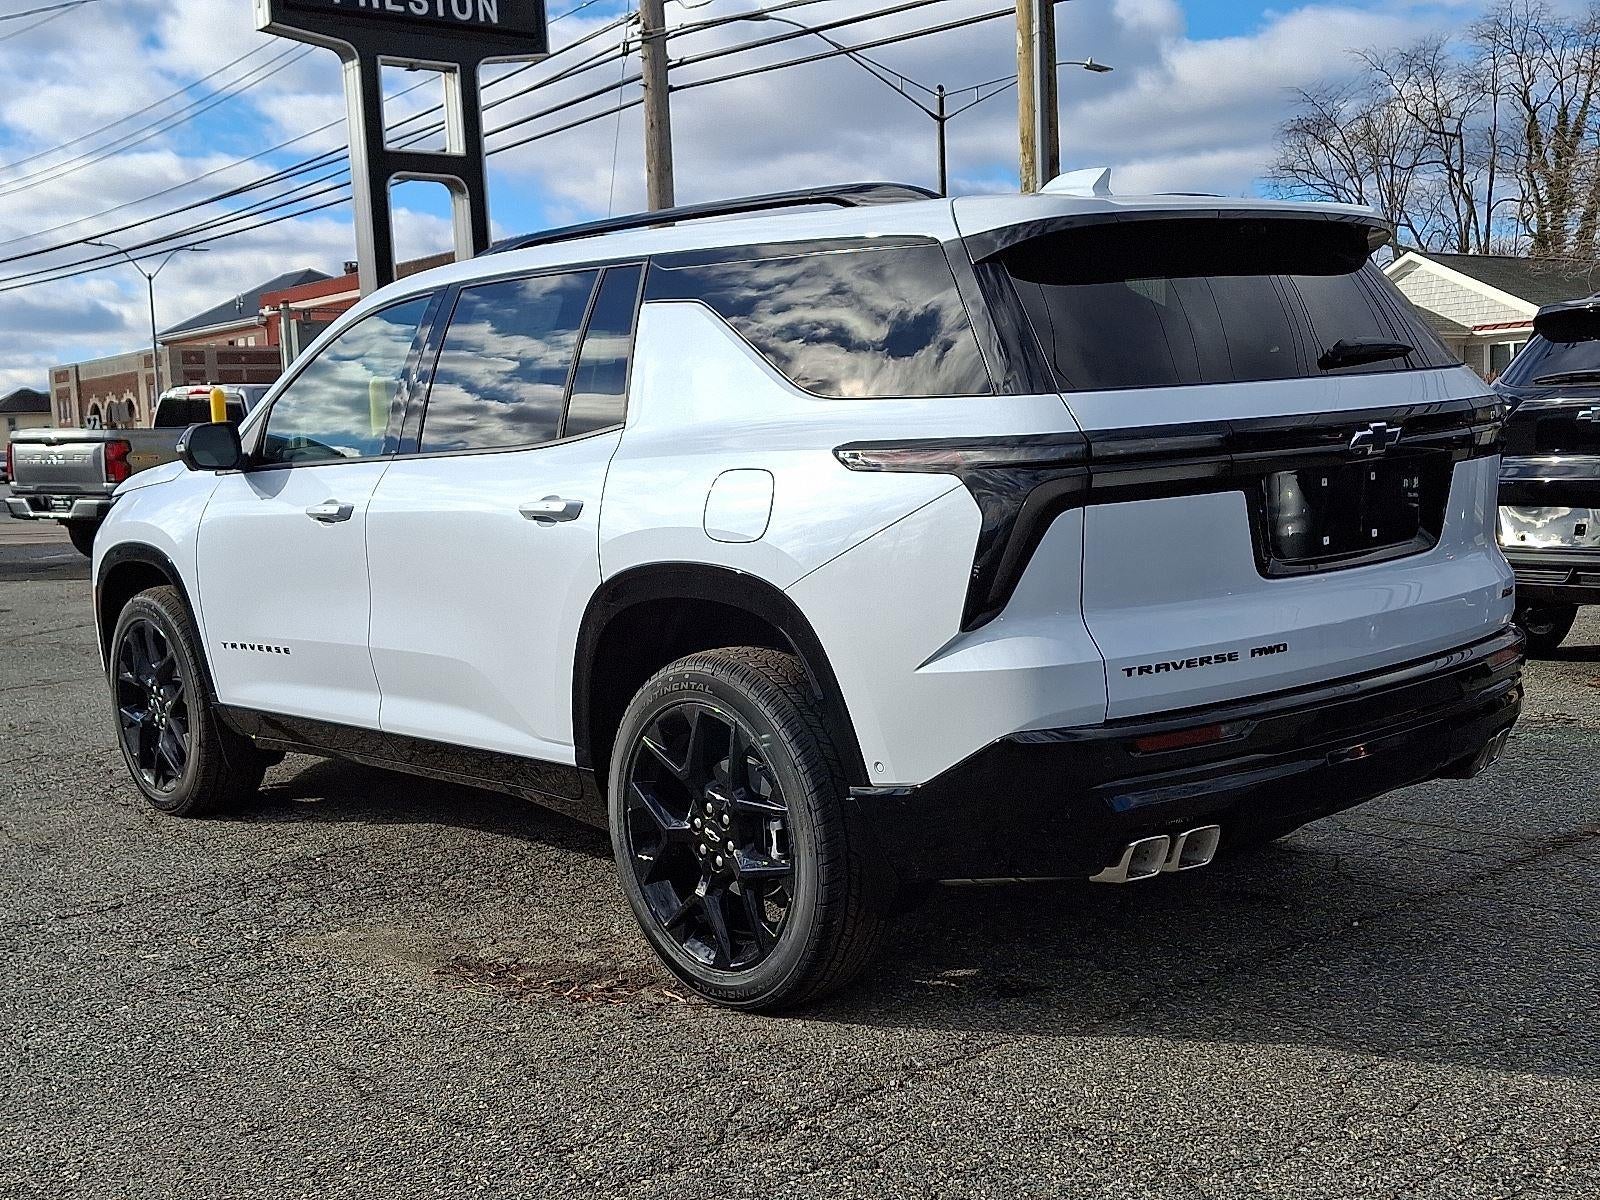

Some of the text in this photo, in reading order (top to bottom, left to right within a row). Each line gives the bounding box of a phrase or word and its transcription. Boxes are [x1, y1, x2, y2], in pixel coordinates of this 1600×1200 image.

[220, 641, 291, 655] TRAVERSE
[1122, 643, 1288, 678] TRAVERSE AWD
[635, 681, 714, 720] NTINENTAL
